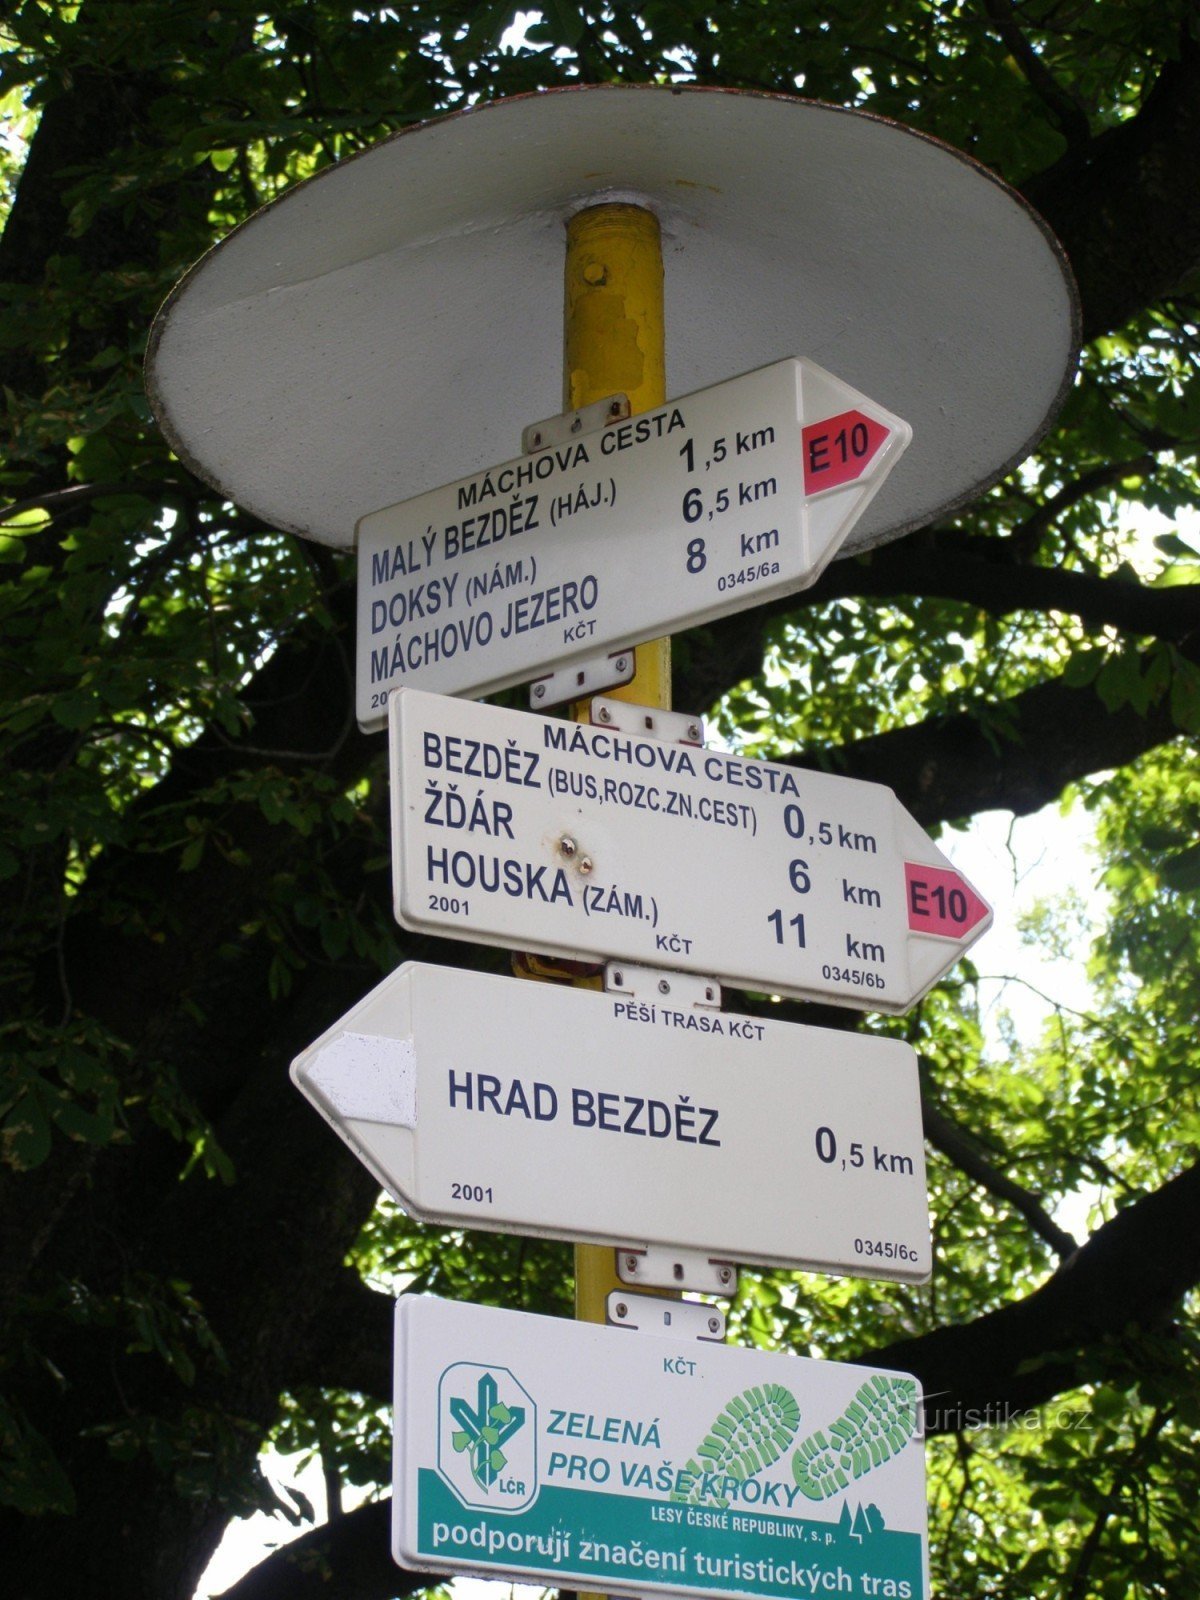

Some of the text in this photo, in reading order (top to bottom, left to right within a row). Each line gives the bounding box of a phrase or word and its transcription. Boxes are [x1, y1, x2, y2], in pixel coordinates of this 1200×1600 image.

[457, 408, 686, 511] MÁCHOVA CESTA
[679, 425, 775, 473] 1,5 km
[808, 422, 869, 474] E10
[682, 476, 778, 523] 6,5 km
[371, 477, 617, 587] MALÝ BEZDĚZ (HÁJ.)
[686, 528, 780, 574] 8 km
[371, 555, 538, 635] DOKSY (NÁM.)
[717, 560, 781, 592] 0345/6a
[370, 574, 600, 684] MÁCHOVO JEZERO
[563, 619, 598, 645] KČT
[371, 687, 396, 709] 20
[423, 731, 541, 788] BEZDĚZ
[543, 724, 801, 798] MÁCHOVA CESTA
[424, 779, 515, 839] ŽĎÁR
[783, 803, 878, 854] 0,5 km
[427, 845, 659, 928] HOUSKA (ZÁM.)
[428, 894, 470, 917] 2001
[788, 858, 882, 908] 6 km
[910, 880, 969, 924] E10
[655, 933, 693, 955] KČT
[767, 908, 886, 963] 11 km
[822, 964, 886, 990] 0345/6b
[614, 1001, 766, 1042] PĚŠÍ TRASA KČT
[448, 1069, 722, 1147] HRAD BEZDĚZ
[815, 1126, 914, 1176] 0,5 km
[451, 1183, 494, 1203] 2001
[854, 1238, 919, 1263] 0345/6c
[663, 1356, 697, 1377] KČT
[546, 1408, 662, 1449] ZELENÁ
[547, 1451, 801, 1509] PRO VAŠE KROKY
[651, 1505, 683, 1525] LESY
[687, 1509, 730, 1531] ČESKÉ
[732, 1517, 809, 1544] REPUBLIKY,
[432, 1520, 912, 1600] podporují značení turistických tras
